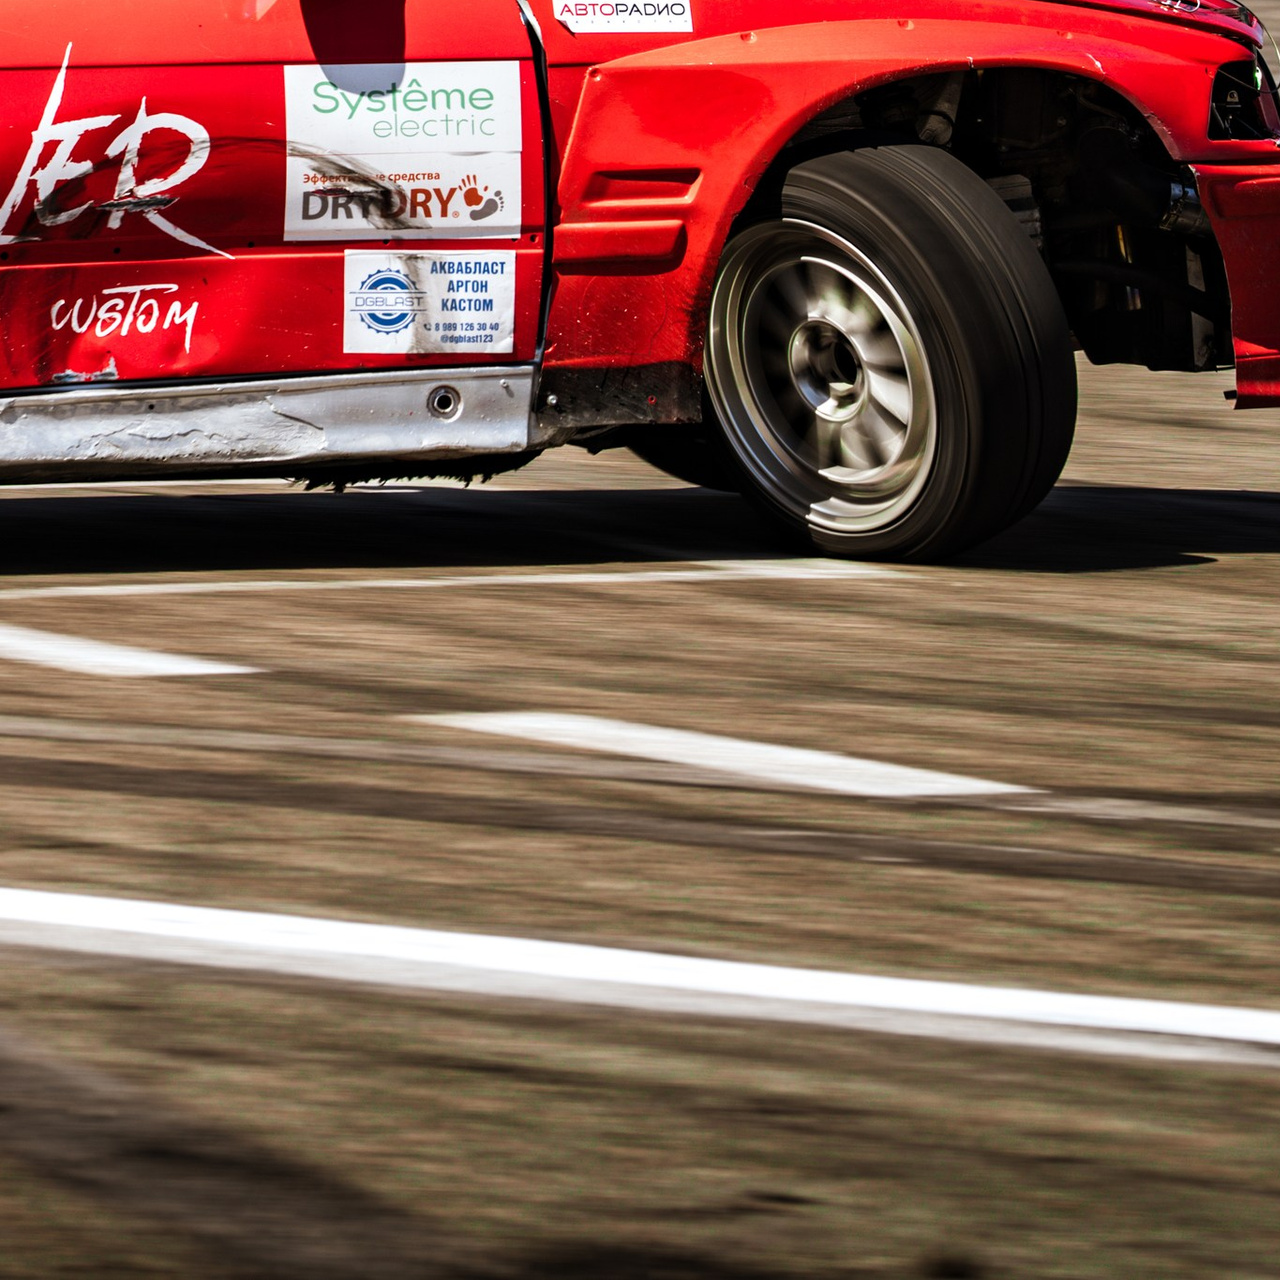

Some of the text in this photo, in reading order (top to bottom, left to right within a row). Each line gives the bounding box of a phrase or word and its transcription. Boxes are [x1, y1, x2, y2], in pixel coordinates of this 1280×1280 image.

[312, 78, 495, 120] Systême
[372, 114, 496, 138] electric
[387, 172, 441, 184] средства
[430, 261, 506, 275] АКВАБЛАСТ
[447, 280, 488, 293] АРГОН
[355, 296, 424, 307] DGBLAST
[441, 299, 494, 312] КАСТОМ
[434, 322, 500, 332] 8 989 126 30 40
[440, 334, 494, 344] @dgblast123
